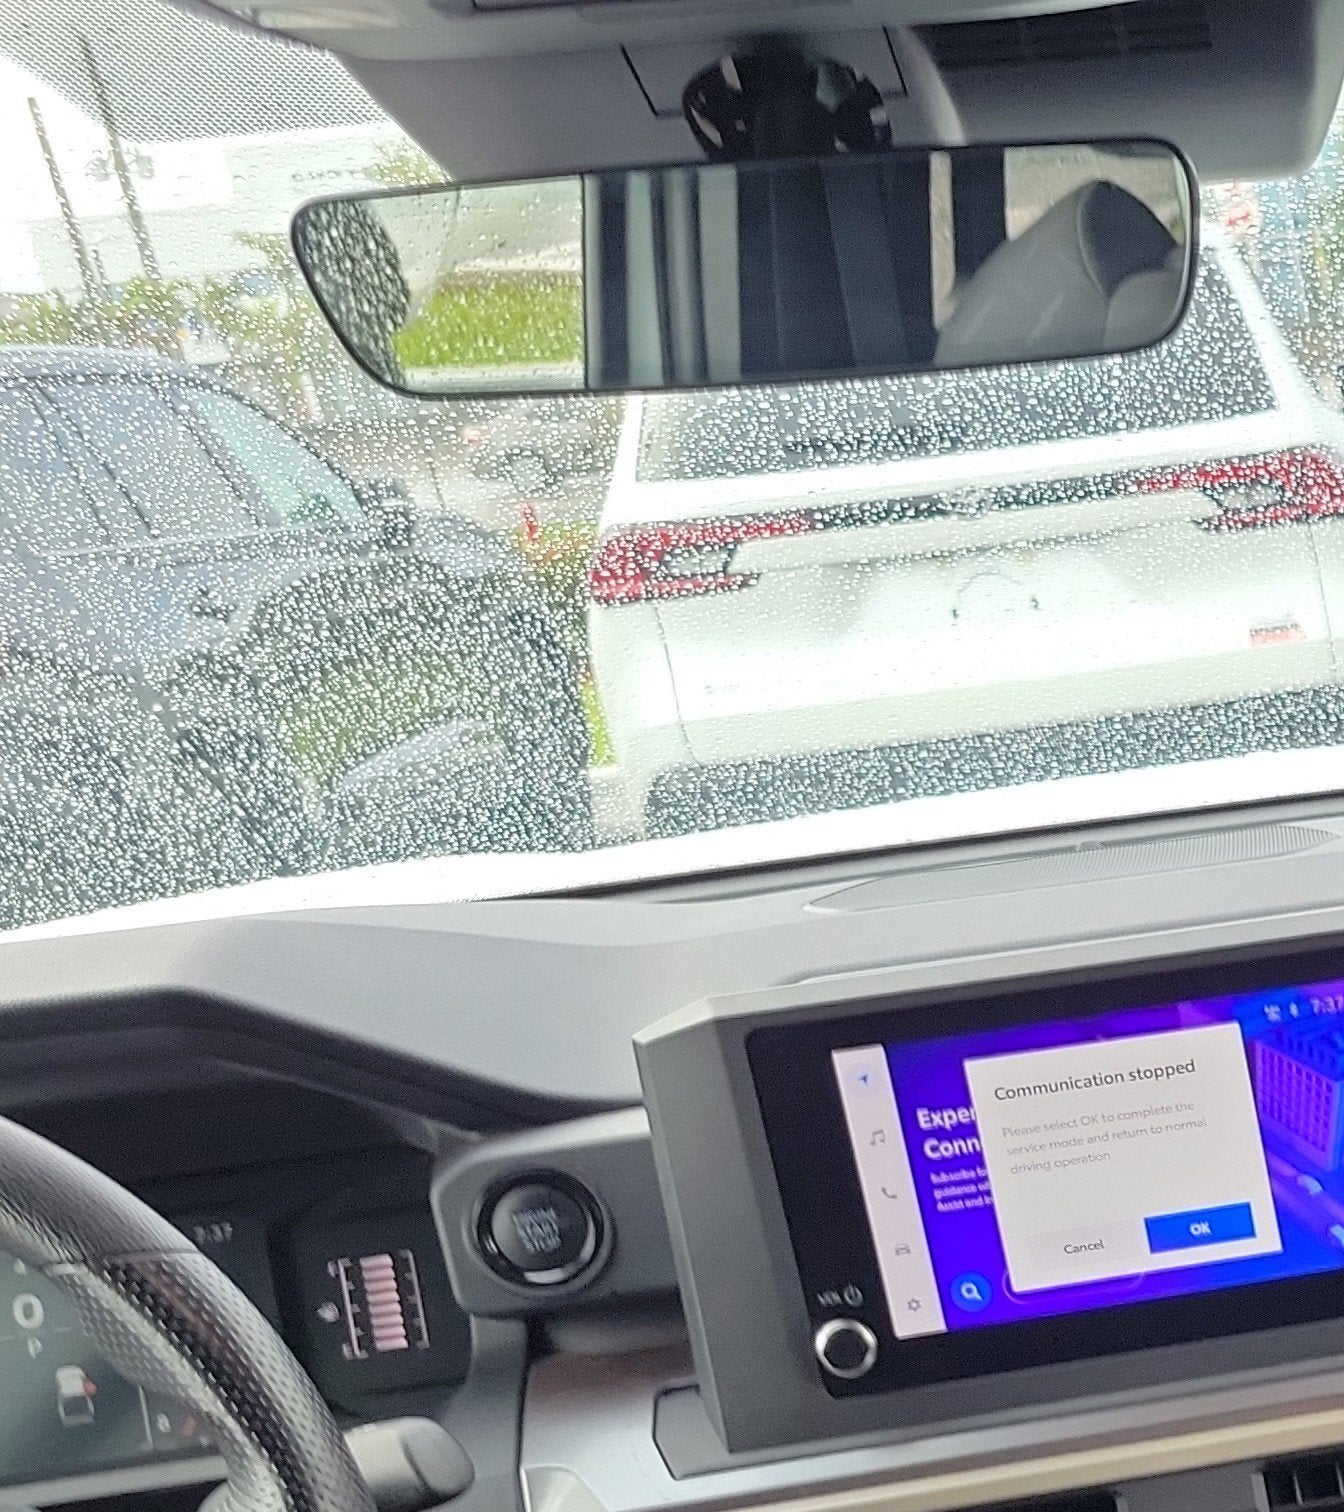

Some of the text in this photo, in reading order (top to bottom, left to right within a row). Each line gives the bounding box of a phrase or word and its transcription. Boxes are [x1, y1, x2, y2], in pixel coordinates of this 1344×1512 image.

[994, 1059, 1196, 1101] Communication stopped
[1002, 1101, 1195, 1138] Please select OK to complete the
[923, 1136, 981, 1160] Conn
[1006, 1117, 1208, 1156] service mode and return to normal
[1009, 1151, 1111, 1175] driving operation
[1189, 1220, 1212, 1237] OK
[1063, 1239, 1106, 1254] Cancel
